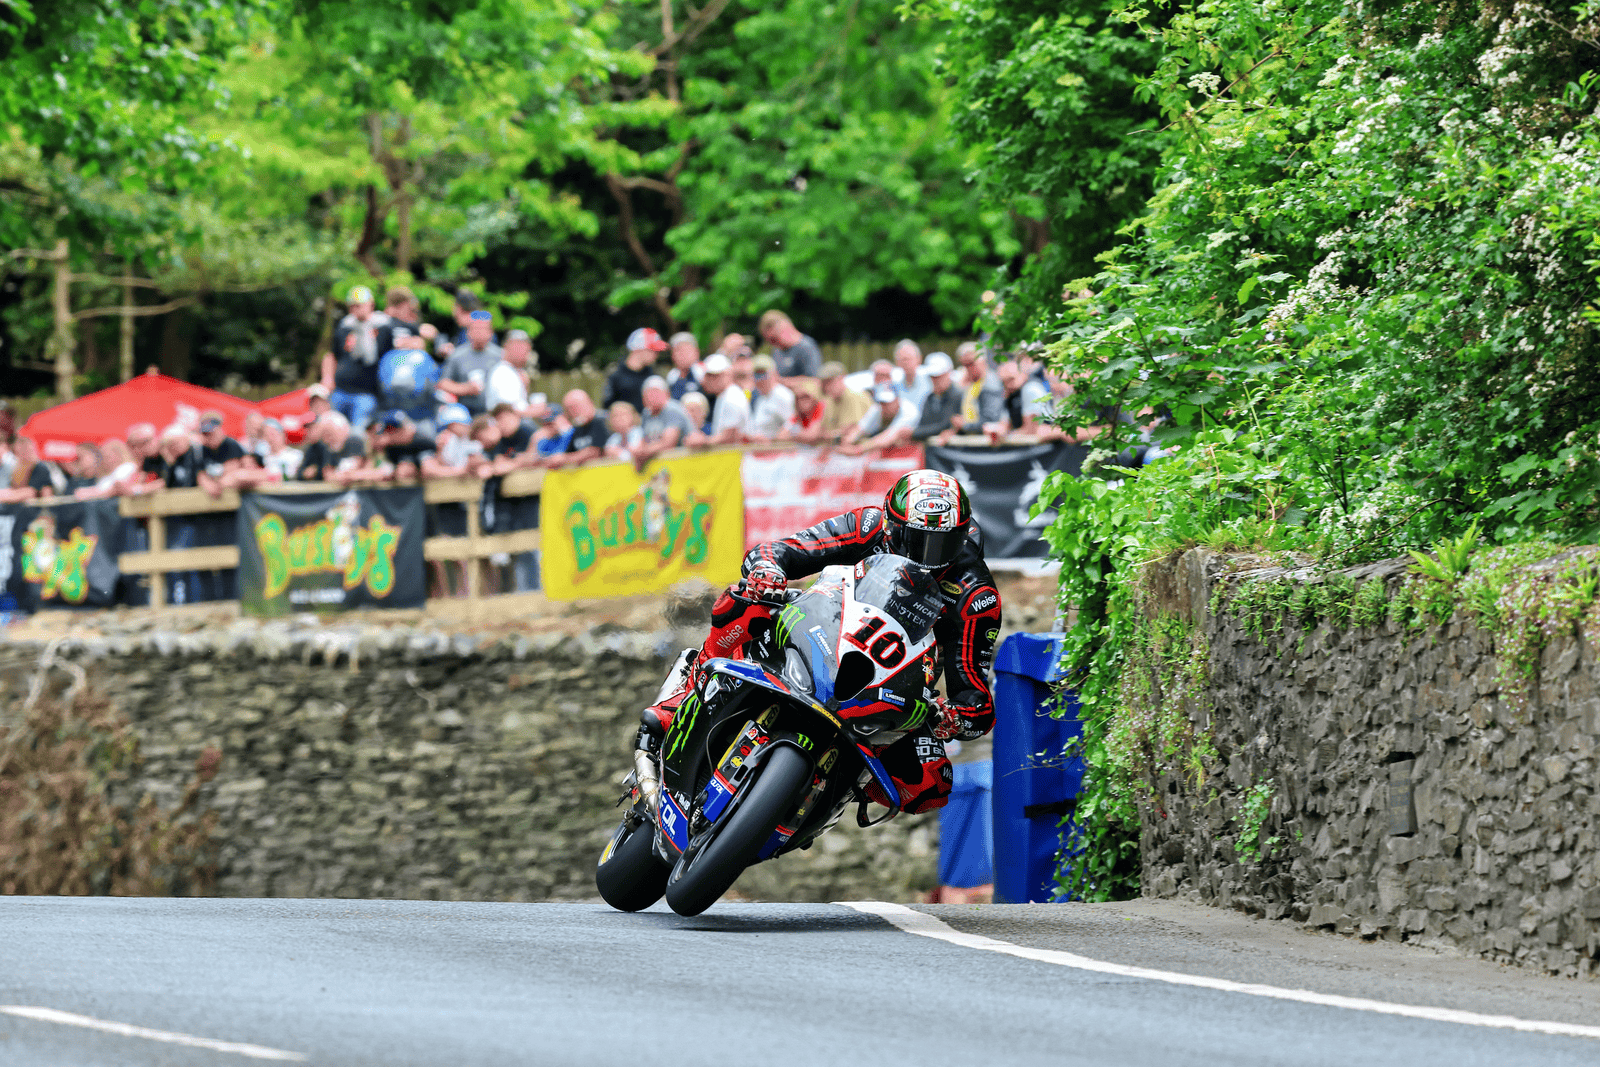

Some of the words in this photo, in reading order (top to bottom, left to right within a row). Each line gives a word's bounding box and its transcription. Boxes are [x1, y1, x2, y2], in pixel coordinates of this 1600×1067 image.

[862, 507, 879, 533] Weise
[971, 594, 997, 612] Weise
[716, 624, 745, 649] Weise
[842, 616, 907, 670] 10
